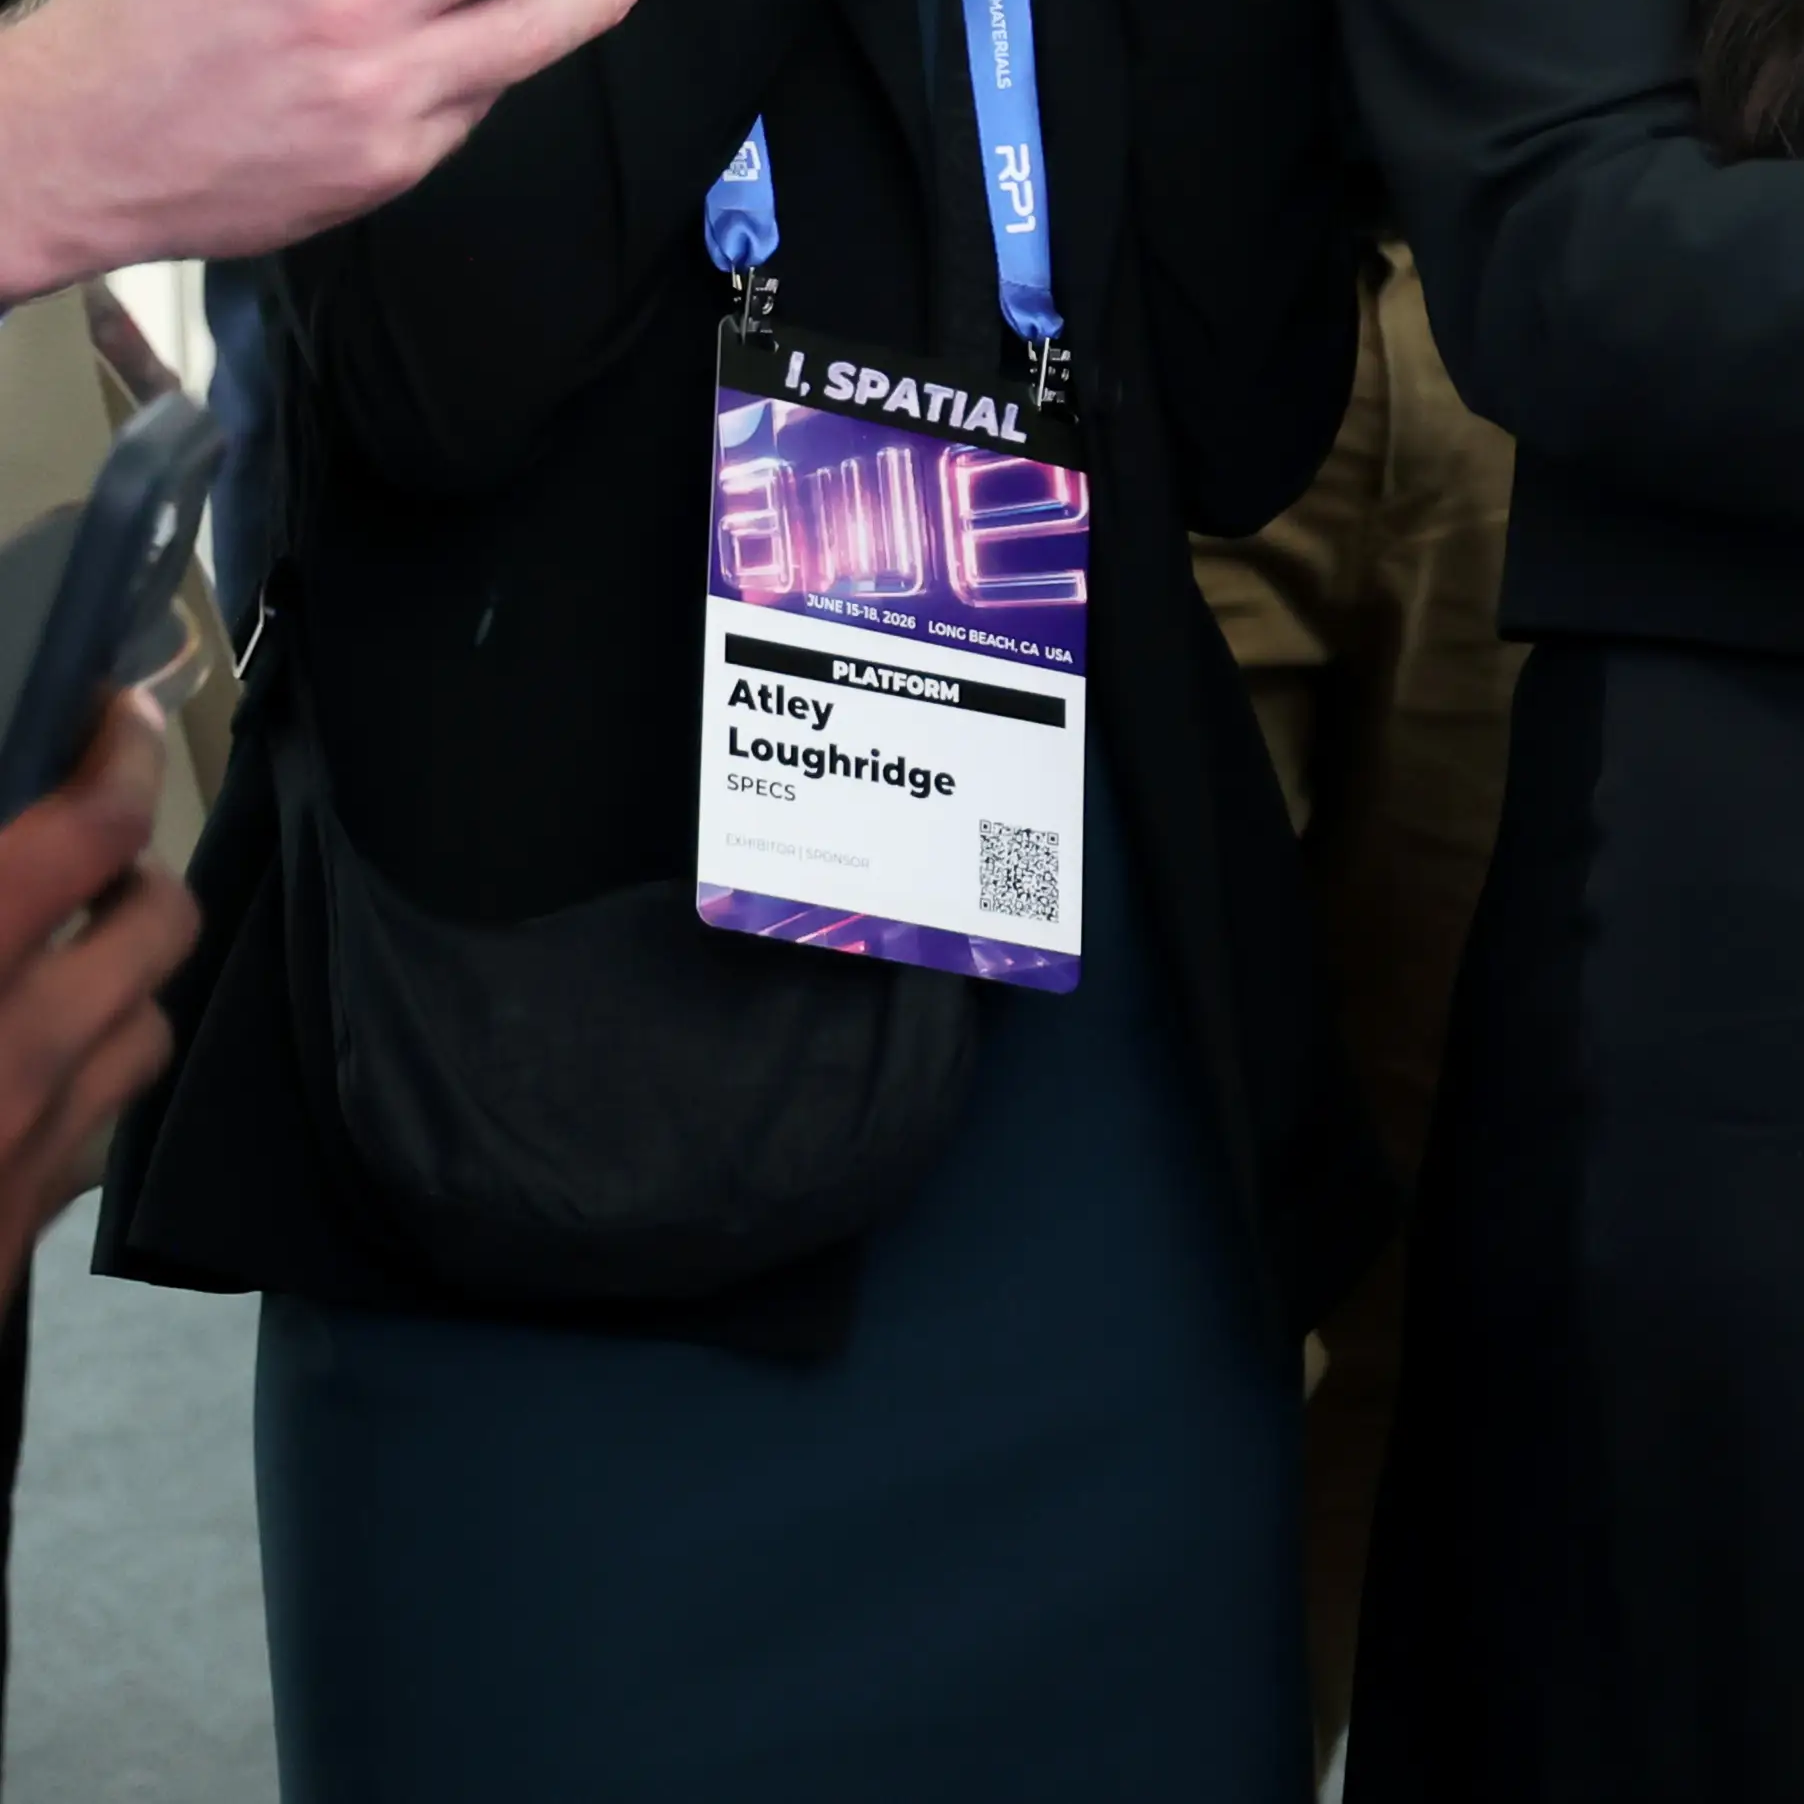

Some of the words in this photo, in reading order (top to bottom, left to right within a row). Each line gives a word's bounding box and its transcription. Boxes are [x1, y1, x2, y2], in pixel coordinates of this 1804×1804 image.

[995, 143, 1036, 234] RP1
[784, 350, 811, 397] I,
[824, 360, 1029, 444] SPATIAL
[807, 593, 843, 616] JUNE
[846, 602, 881, 623] 15-18,
[882, 610, 917, 630] 2026
[928, 620, 966, 641] LONG
[968, 629, 1018, 654] BEACH,
[1020, 640, 1039, 657] CA
[1044, 645, 1074, 664] USA
[727, 678, 834, 732] Atley
[832, 659, 960, 704] PLATFORM
[727, 772, 796, 803] SPECS
[728, 725, 956, 800] Loughridge
